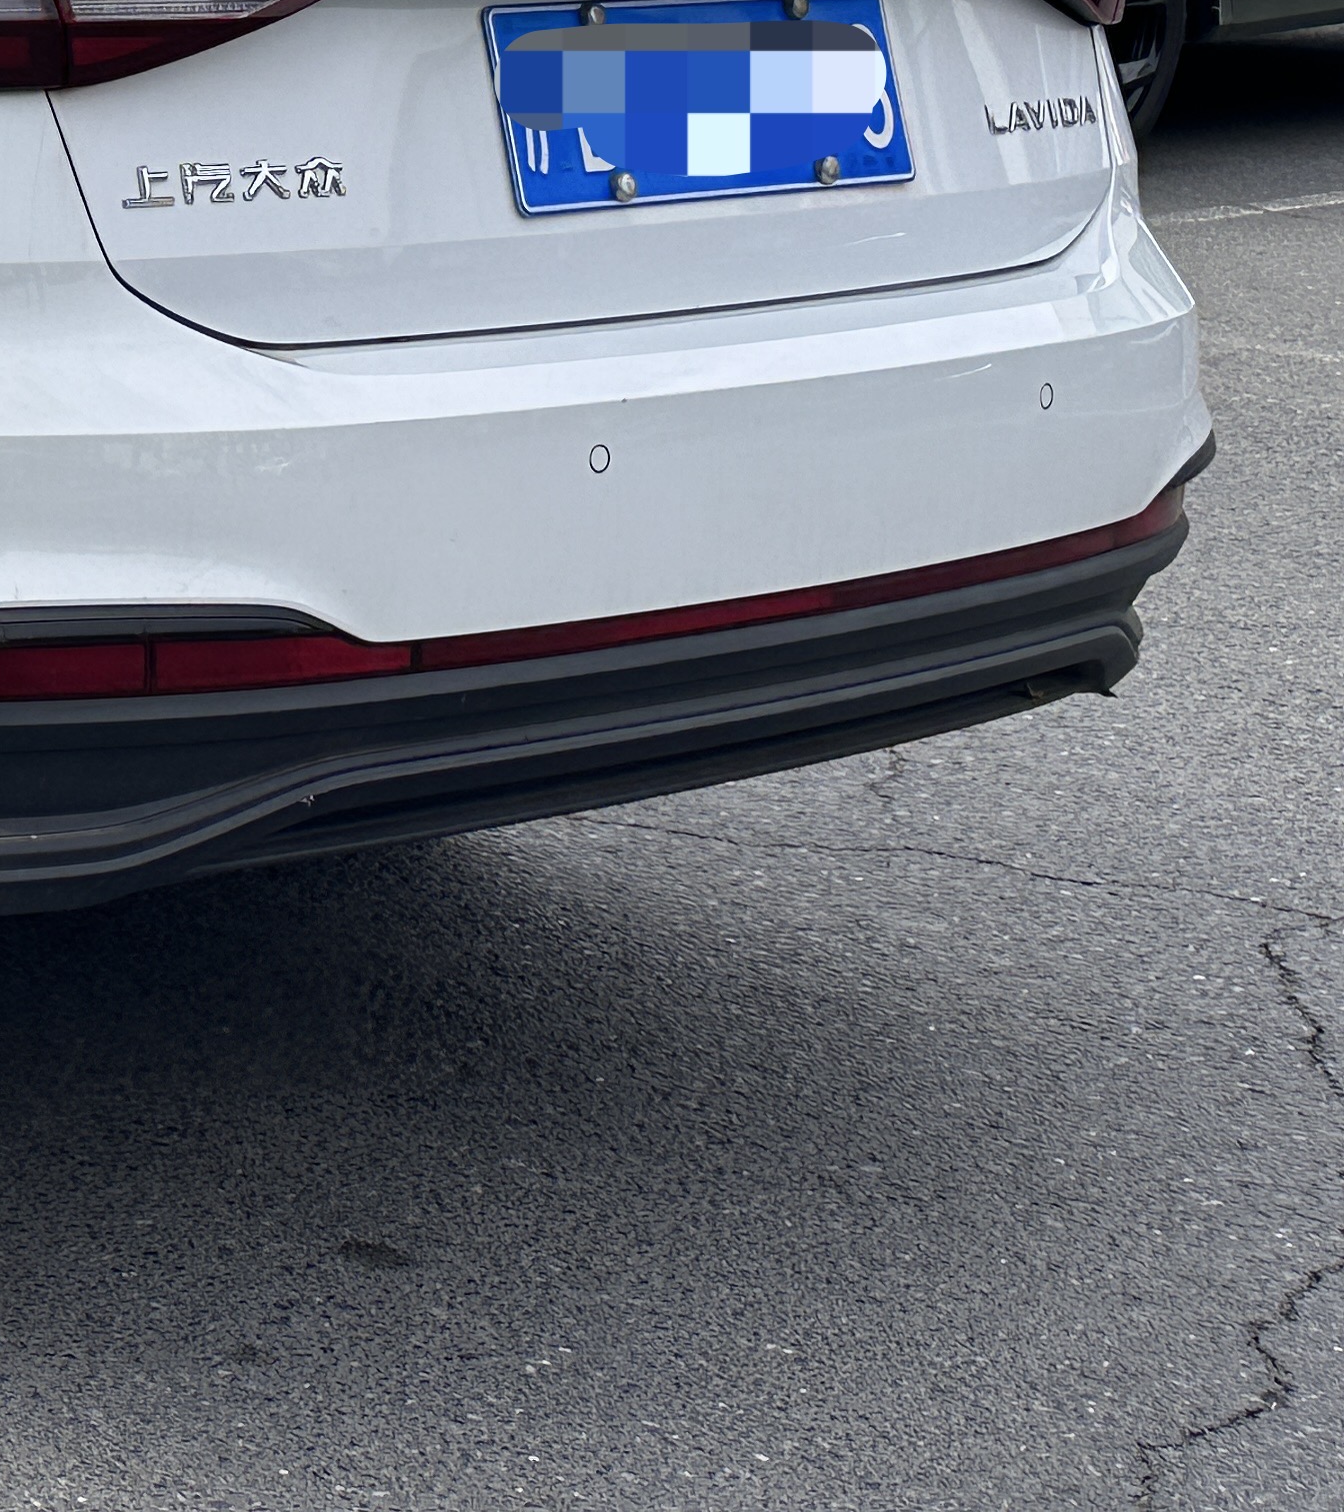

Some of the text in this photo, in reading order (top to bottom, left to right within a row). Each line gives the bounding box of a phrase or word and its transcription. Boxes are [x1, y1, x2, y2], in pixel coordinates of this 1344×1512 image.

[984, 95, 1096, 135] LAVIDA
[121, 156, 347, 209] 上汽大众
